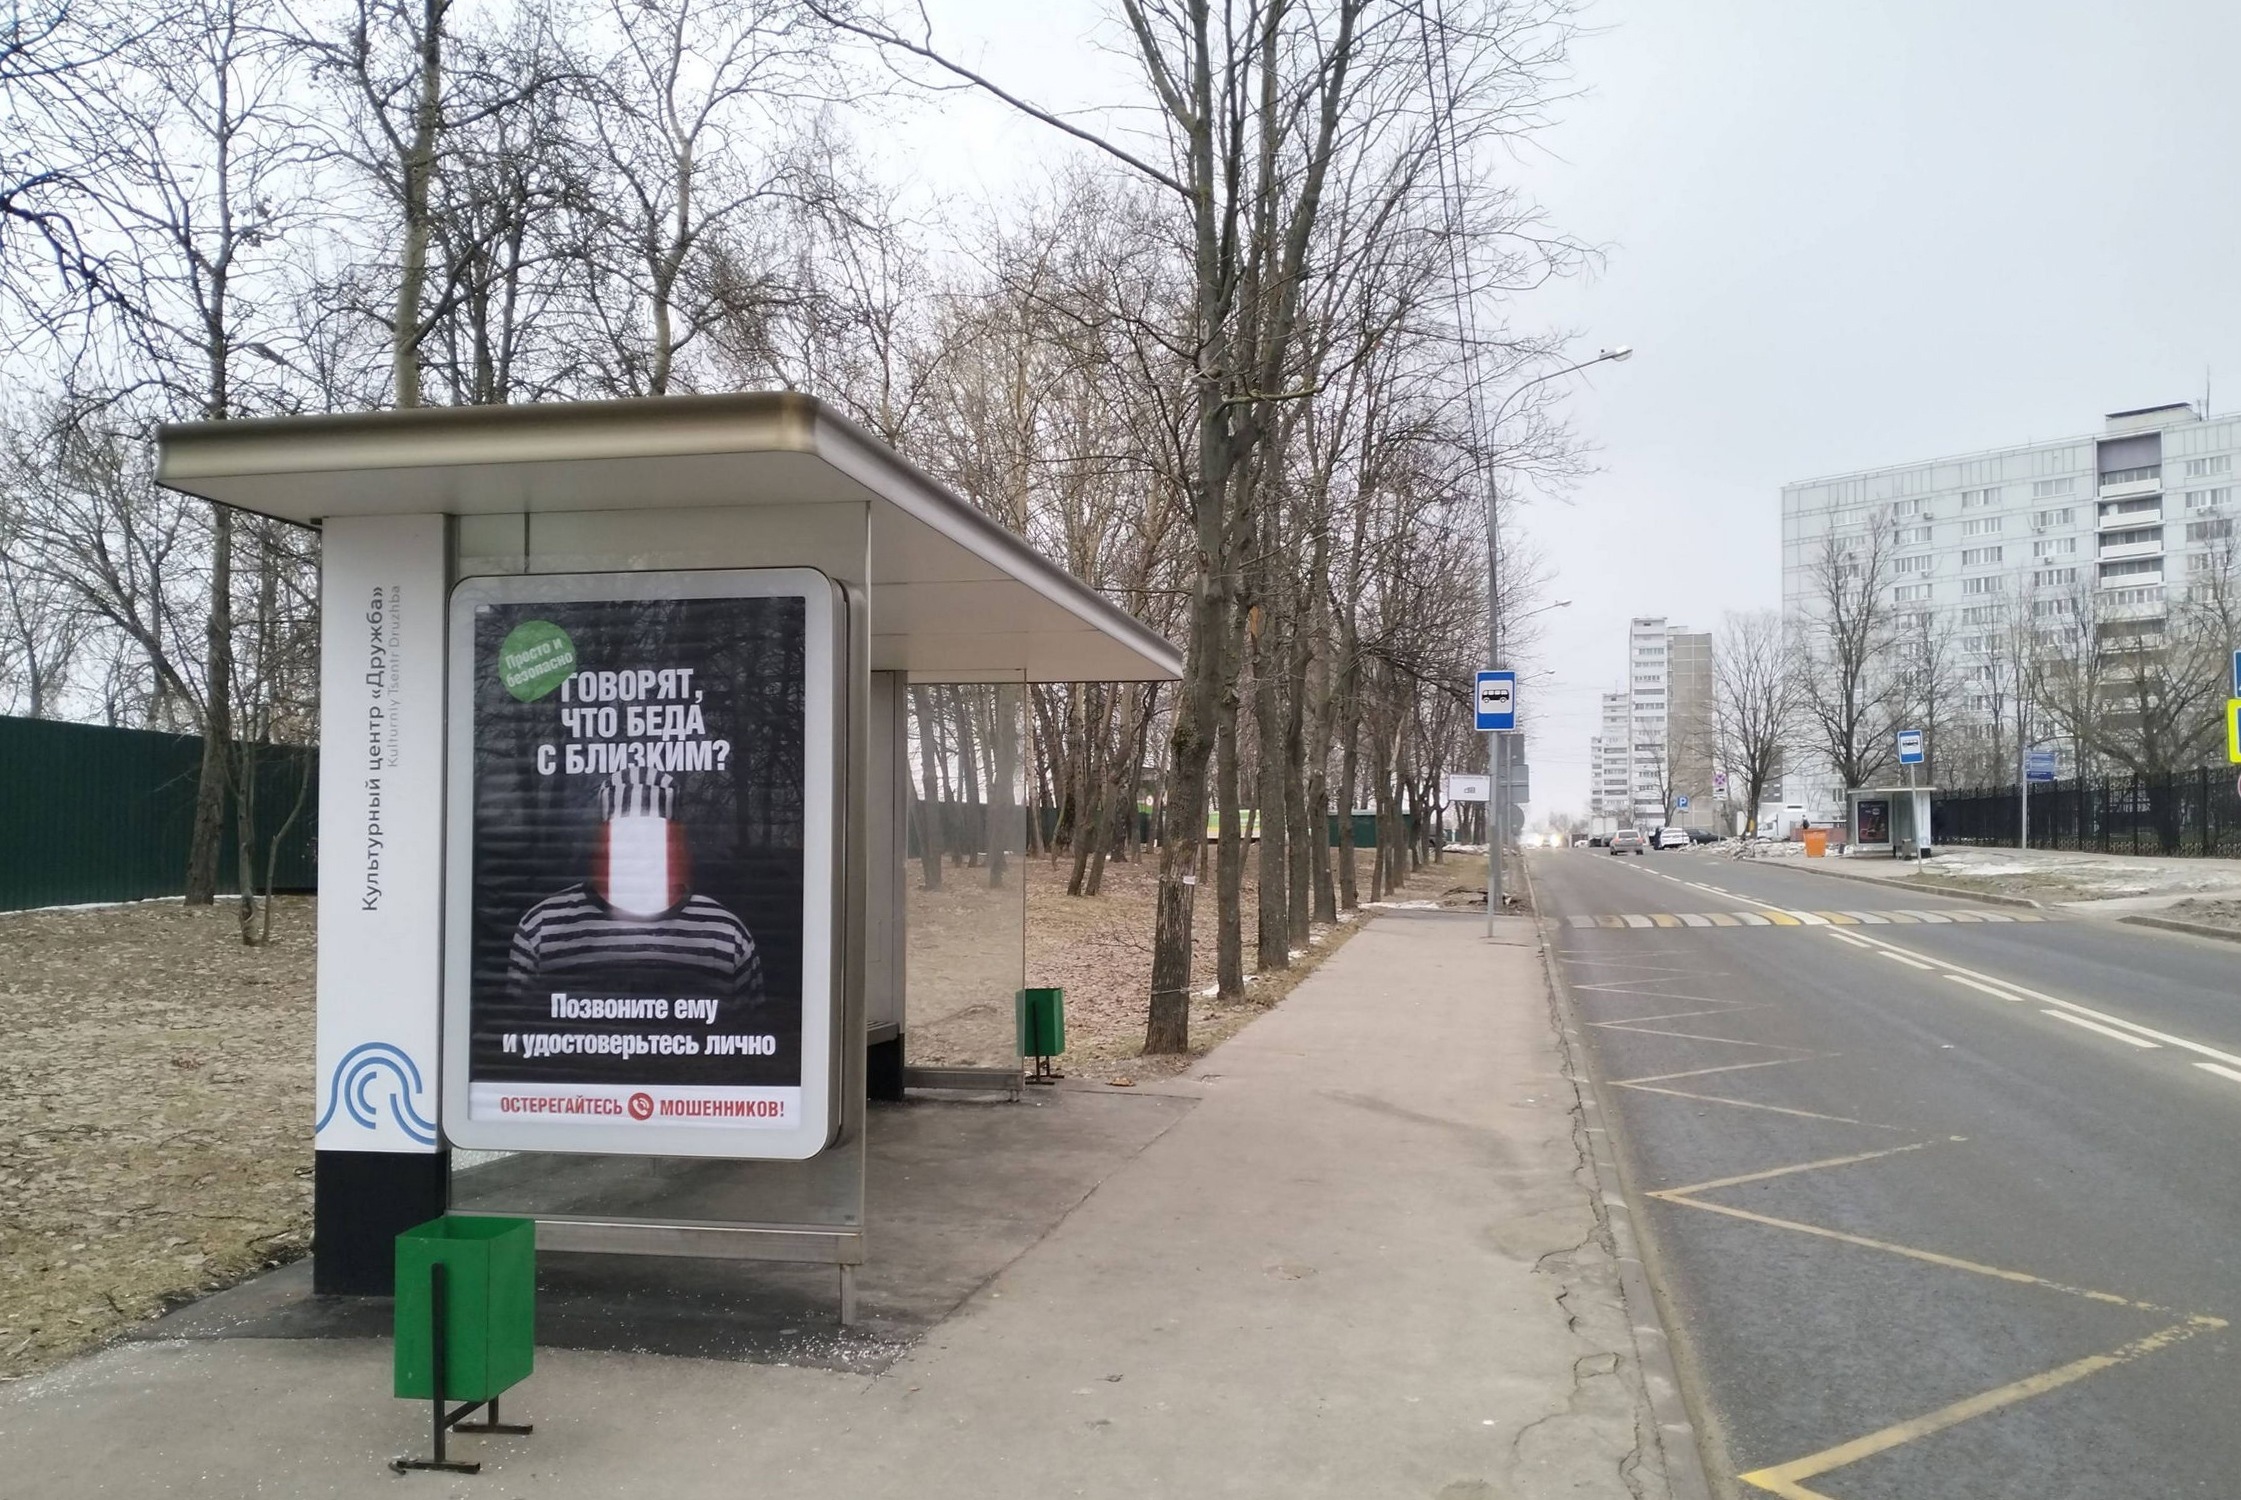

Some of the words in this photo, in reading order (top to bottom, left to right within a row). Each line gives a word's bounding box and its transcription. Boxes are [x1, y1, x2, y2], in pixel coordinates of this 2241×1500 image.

[388, 585, 401, 648] Druzhba
[366, 586, 387, 700] «Дружба»
[505, 643, 551, 669] Просто
[552, 638, 563, 649] и
[388, 652, 401, 695] Tsentr
[506, 652, 574, 688] безопасно
[561, 668, 704, 704] ГОВОРЯТ,
[368, 706, 385, 770] центр
[561, 706, 618, 738] ЧТО
[626, 704, 706, 741] БЕДА
[537, 744, 556, 775] С
[565, 740, 731, 775] БЛИЗКИМ?
[362, 778, 384, 911] Культурный
[551, 993, 669, 1019] Позвоните
[674, 998, 718, 1025] ему
[502, 1034, 517, 1053] и
[522, 1033, 699, 1060] удостоверьтесь
[704, 1034, 776, 1056] лично
[500, 1095, 623, 1116] ОСТЕРЕГАЙТЕСЬ
[659, 1099, 785, 1118] МОШЕННИКОВ!
